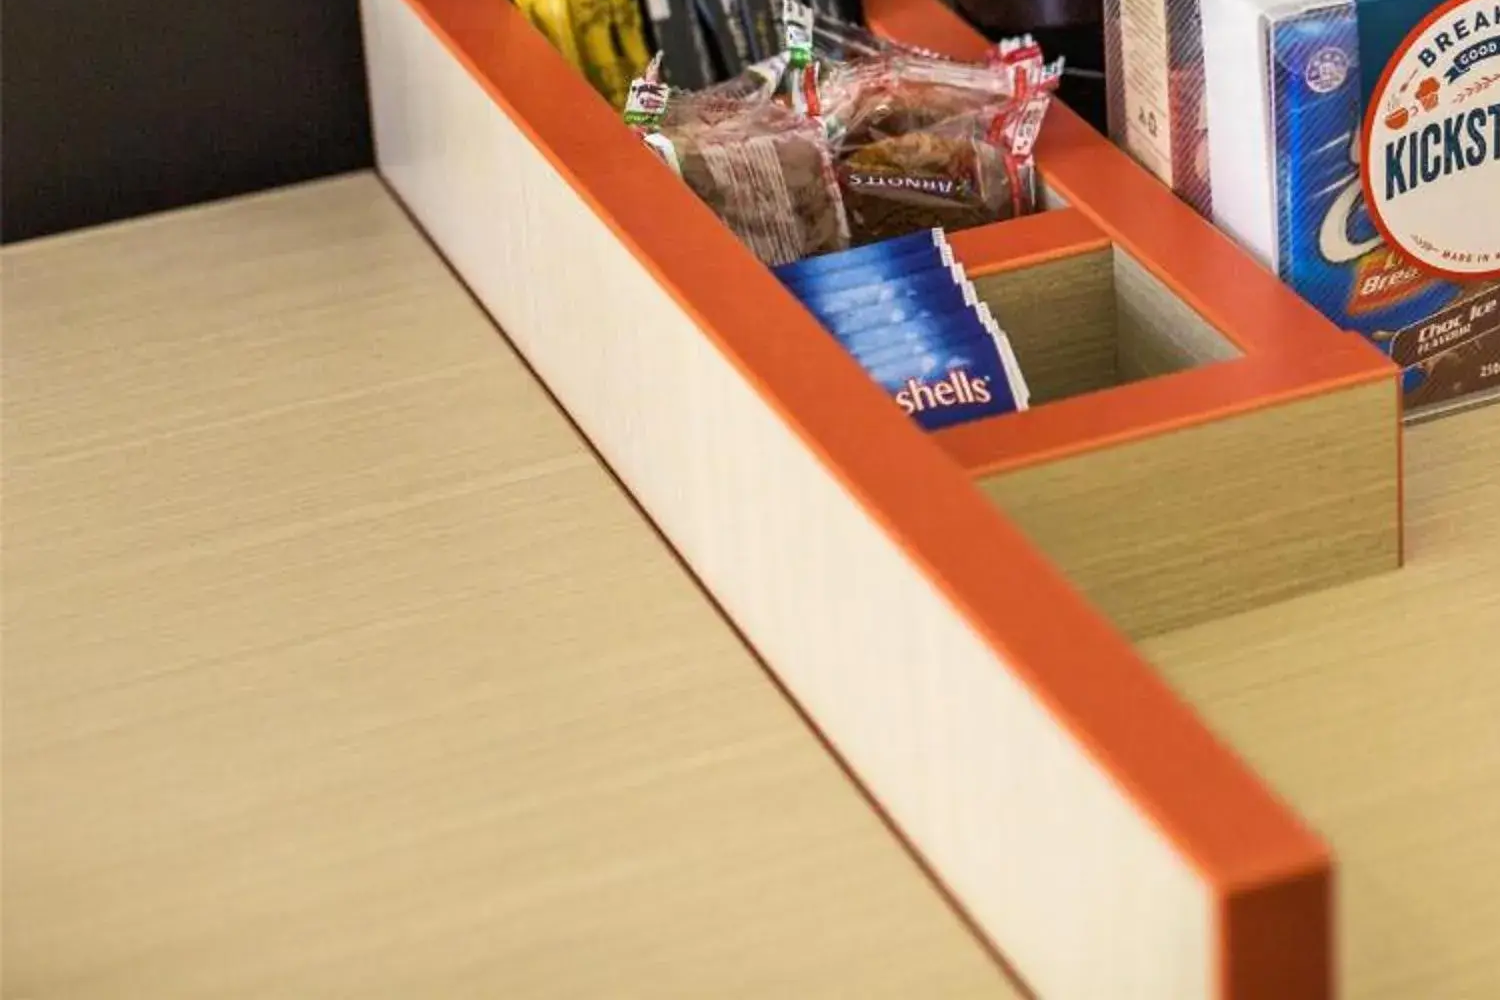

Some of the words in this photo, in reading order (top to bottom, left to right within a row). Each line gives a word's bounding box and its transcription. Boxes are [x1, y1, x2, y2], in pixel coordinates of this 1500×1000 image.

[1459, 41, 1498, 65] GOOD
[1441, 250, 1473, 264] MADE
[1477, 253, 1491, 264] IN
[1417, 314, 1464, 343] Choc
[895, 371, 992, 415] shells
